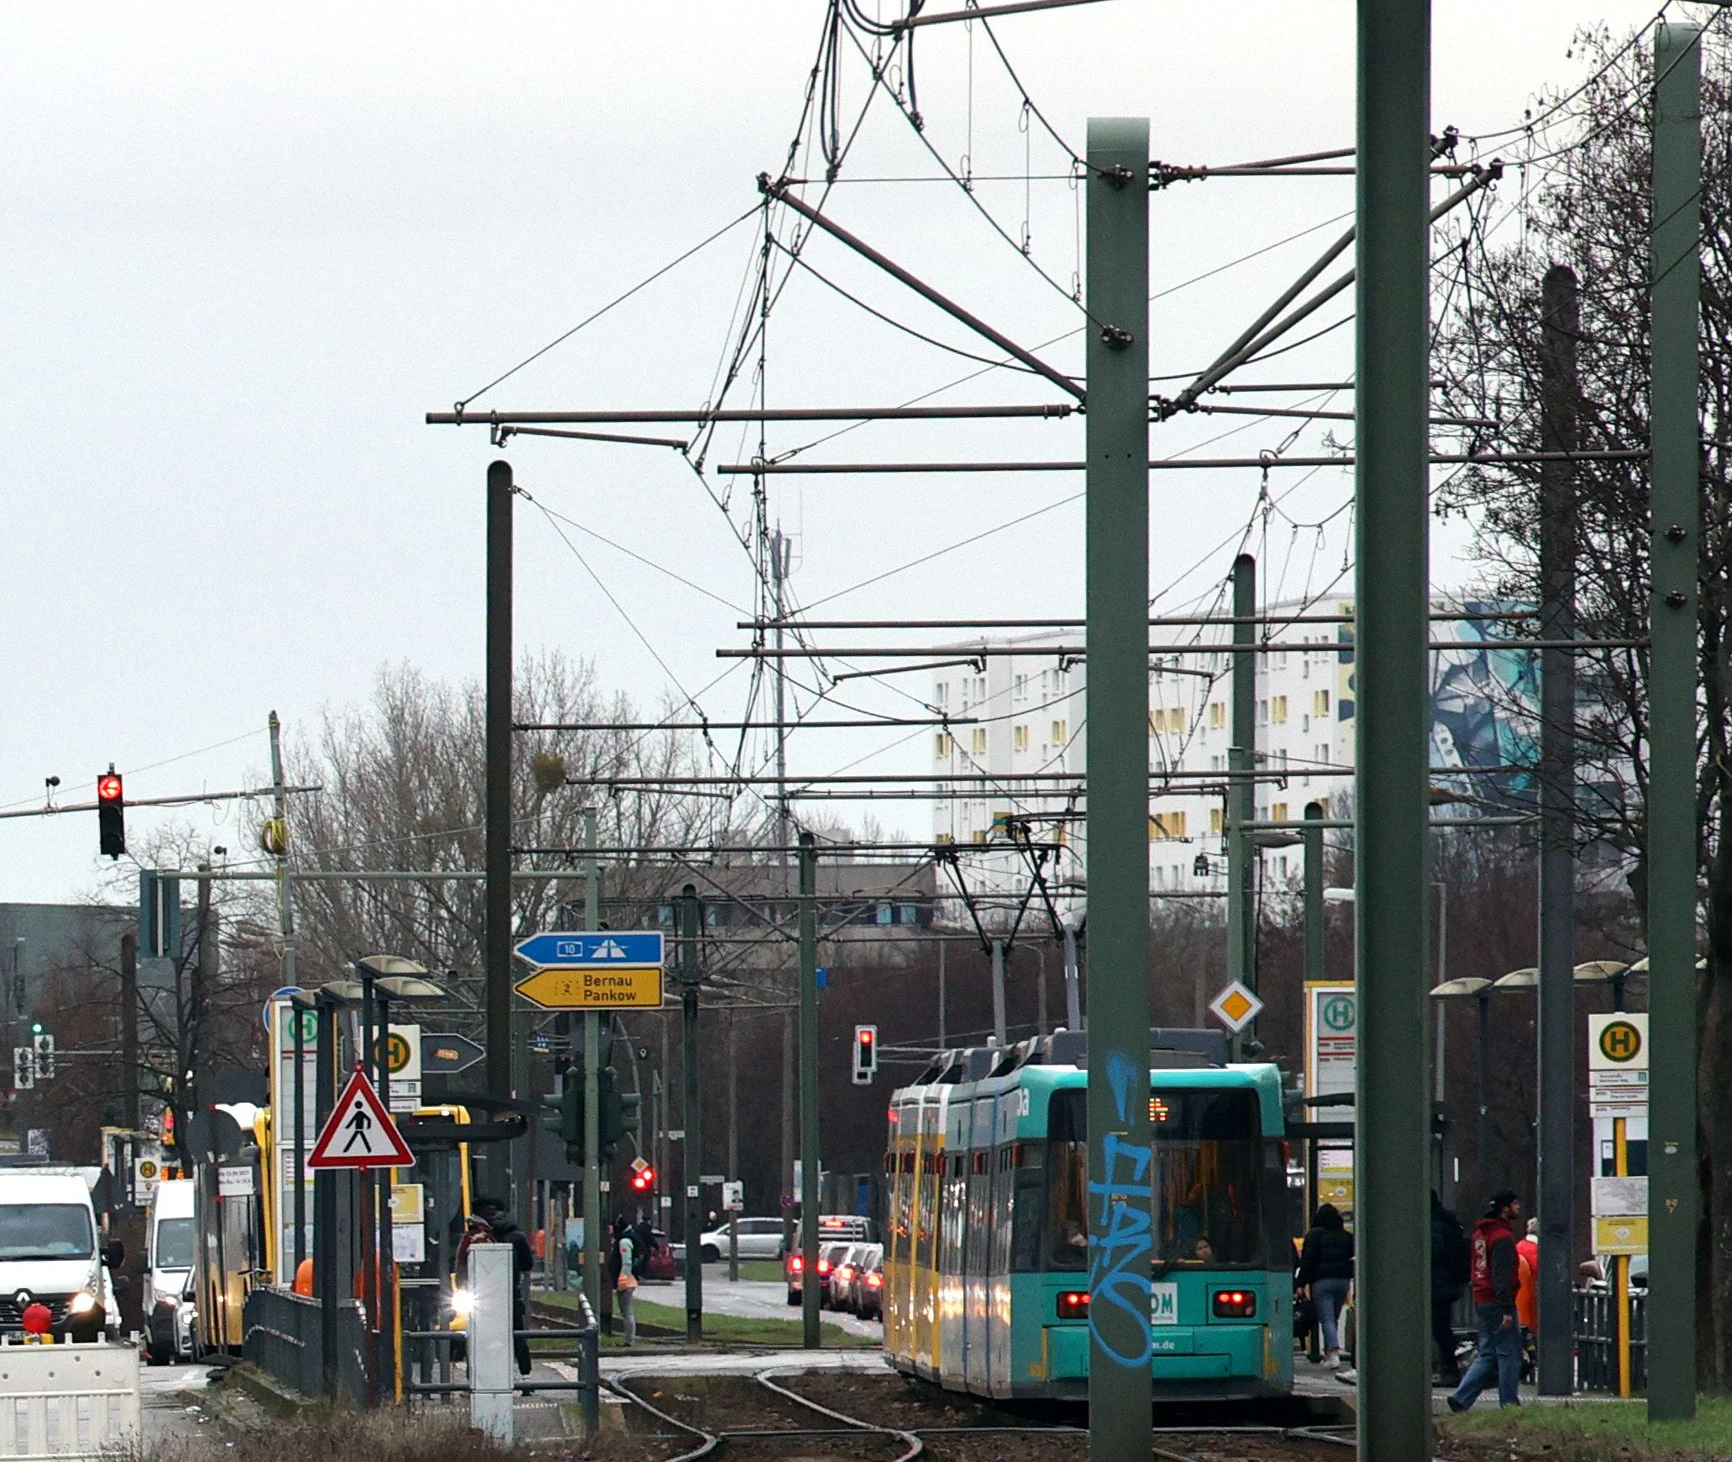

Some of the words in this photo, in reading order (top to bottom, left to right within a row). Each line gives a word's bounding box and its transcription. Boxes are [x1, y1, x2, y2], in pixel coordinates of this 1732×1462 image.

[564, 944, 576, 954] 10
[584, 975, 632, 987] Bernau
[584, 990, 637, 1002] Pankow
[1610, 1030, 1630, 1052] H
[1152, 1340, 1175, 1350] m.de
